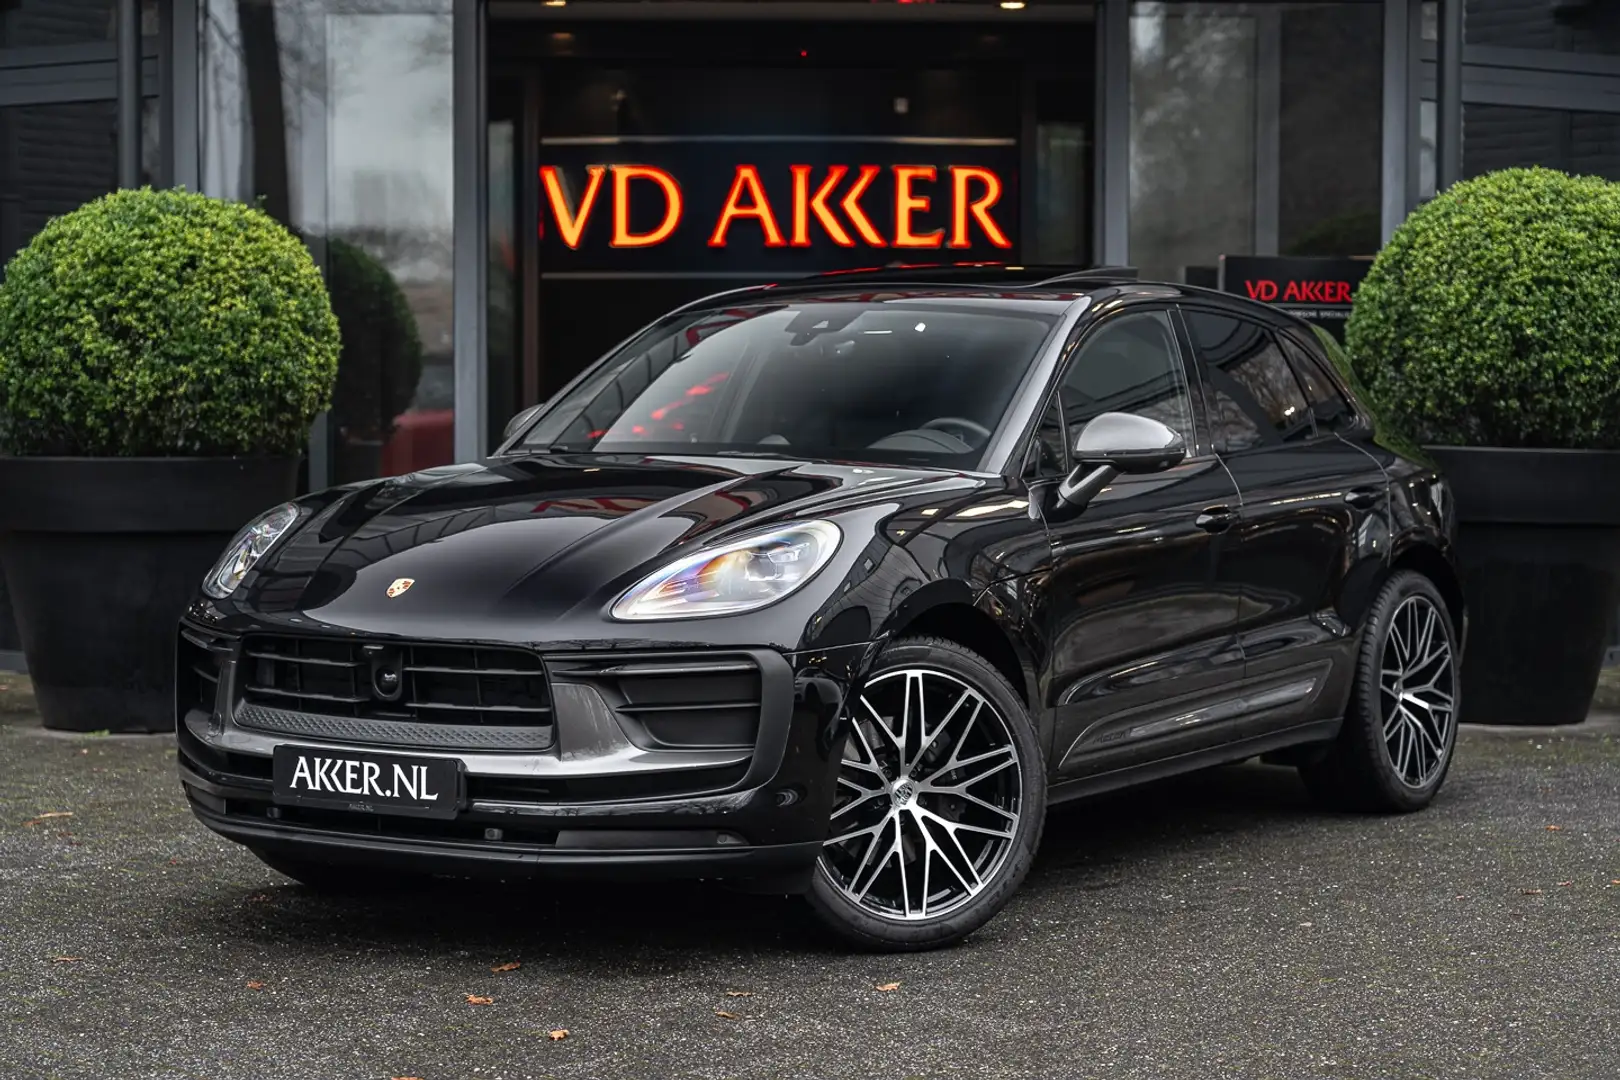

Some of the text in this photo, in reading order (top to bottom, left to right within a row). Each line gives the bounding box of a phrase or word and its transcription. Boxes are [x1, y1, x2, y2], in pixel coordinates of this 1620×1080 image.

[539, 164, 1013, 249] VD AKKER
[1245, 280, 1353, 303] VD AKKER
[289, 756, 439, 800] AKKER.NL
